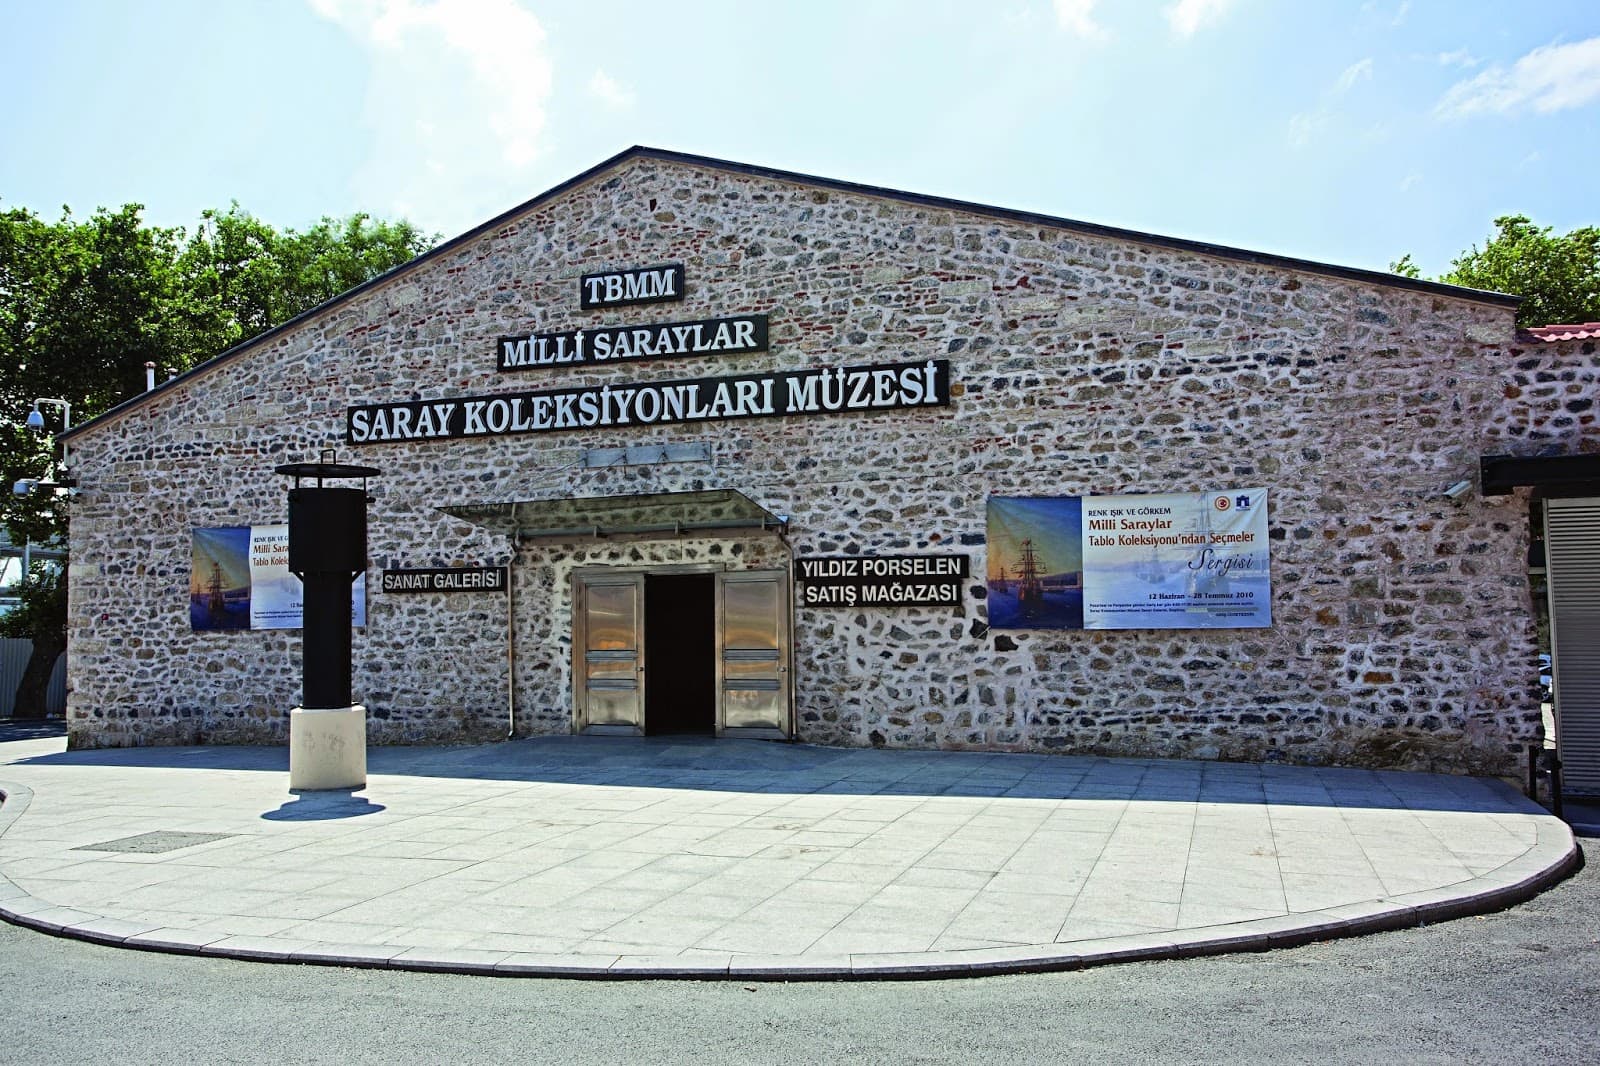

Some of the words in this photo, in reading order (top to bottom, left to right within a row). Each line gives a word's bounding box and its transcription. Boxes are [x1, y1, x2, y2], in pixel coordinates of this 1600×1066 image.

[584, 268, 677, 303] TBMM
[502, 331, 586, 367] MİLLİ
[593, 320, 757, 361] SARAYLAR
[351, 403, 456, 442] SARAY
[463, 378, 776, 434] KOLEKSİYONLARI
[785, 360, 939, 412] MÜZESİ
[1088, 509, 1107, 517] RENK
[1137, 506, 1171, 516] GÖRKEM
[1088, 519, 1116, 531] Milli
[1120, 518, 1173, 532] Saraylar
[253, 544, 271, 554] Milli
[272, 543, 289, 553] Sara
[1088, 535, 1115, 546] Tablo
[1118, 533, 1206, 548] Koleksiyonu'ndan
[1209, 531, 1255, 546] Seçmeler
[252, 557, 269, 567] Tablo
[802, 560, 858, 577] YILDIZ
[862, 558, 961, 576] PORSELEN
[1188, 548, 1253, 577] Sergisi
[384, 574, 431, 590] SANAT
[433, 569, 500, 588] GALERİSİ
[806, 585, 857, 606] SATIŞ
[862, 582, 957, 602] MAĞAZASI
